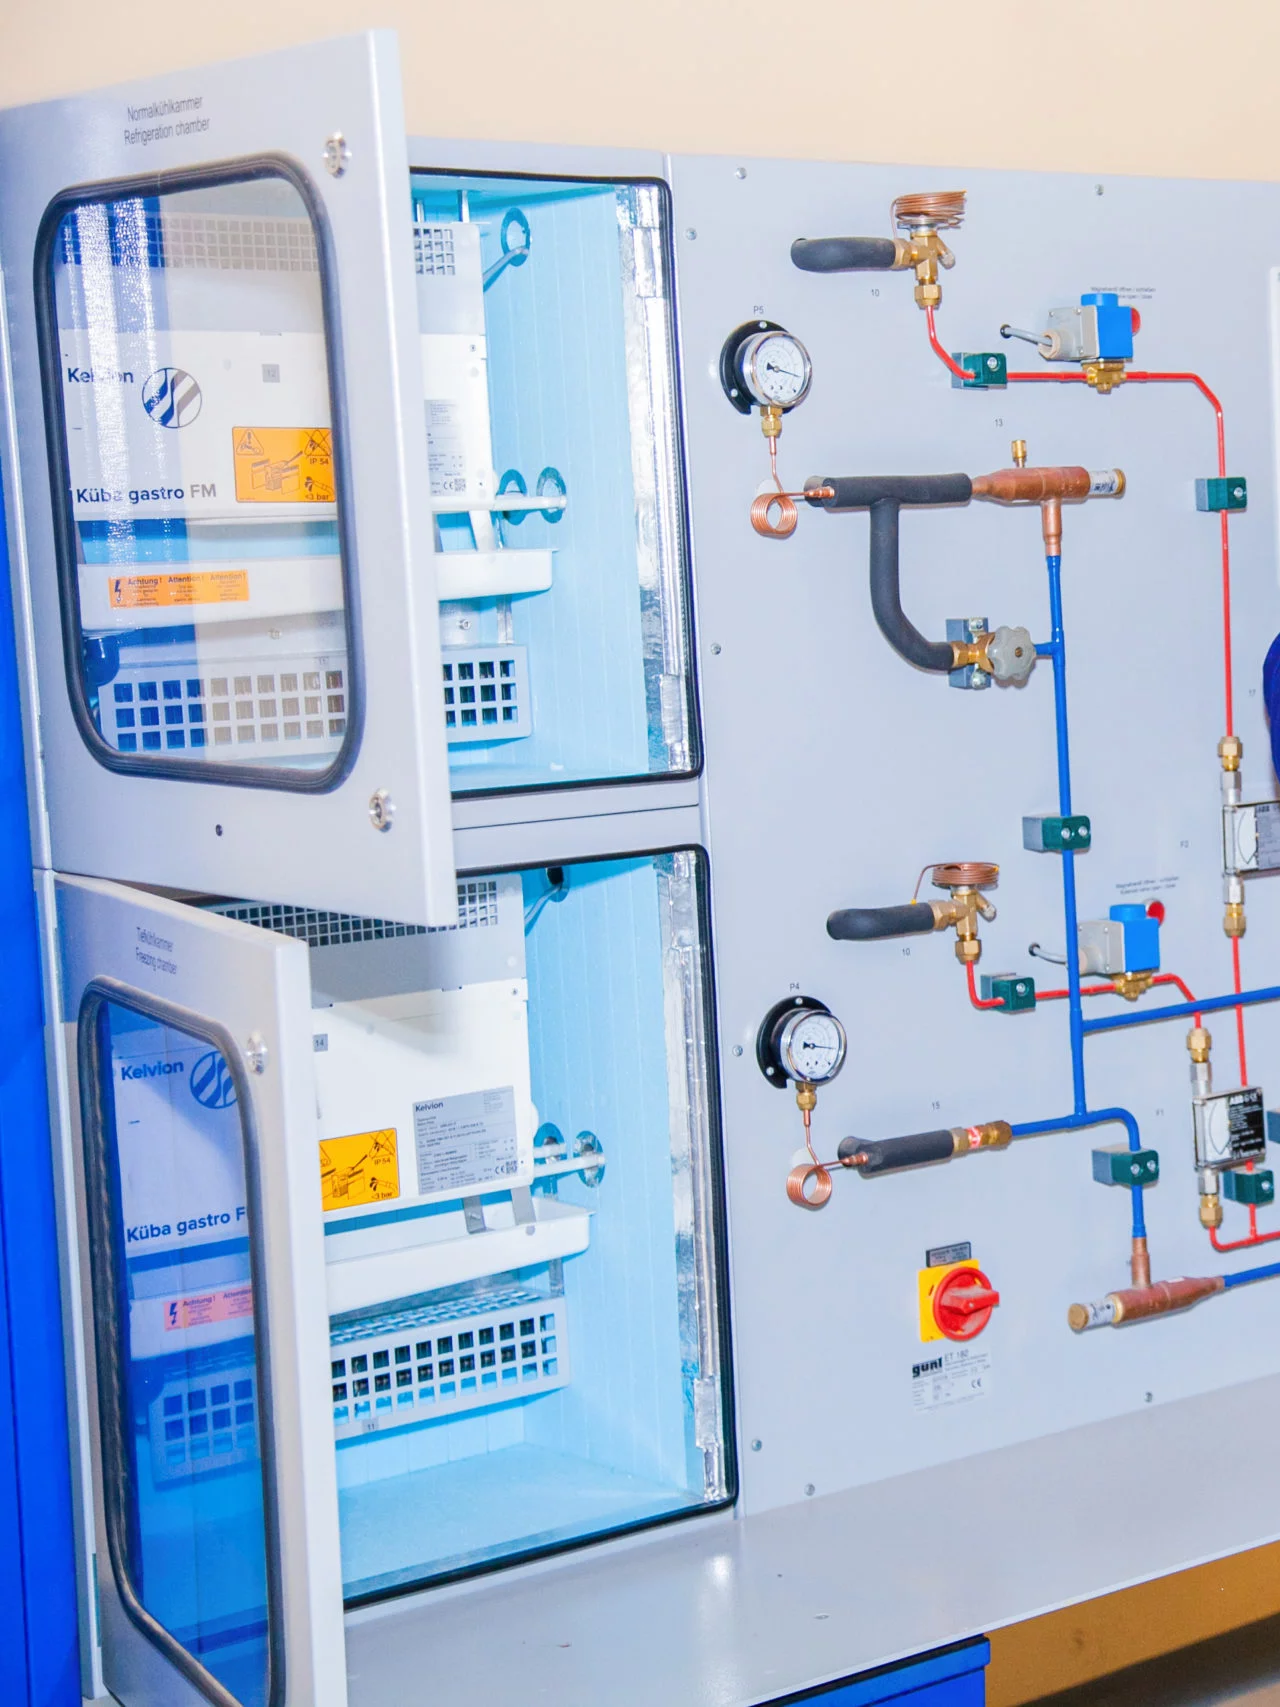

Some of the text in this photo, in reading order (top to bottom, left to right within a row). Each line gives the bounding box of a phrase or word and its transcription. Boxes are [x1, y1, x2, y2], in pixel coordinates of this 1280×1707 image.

[127, 96, 204, 121] Normalkühlkammer
[123, 117, 211, 146] Refrigeration chamber
[129, 486, 185, 504] gastro
[190, 483, 217, 498] FM
[789, 982, 800, 992] P4
[315, 1039, 324, 1047] 14
[121, 1061, 184, 1080] Kelvion
[415, 1101, 444, 1112] Kelvion
[127, 1223, 171, 1242] Küba
[176, 1212, 231, 1236] gastro
